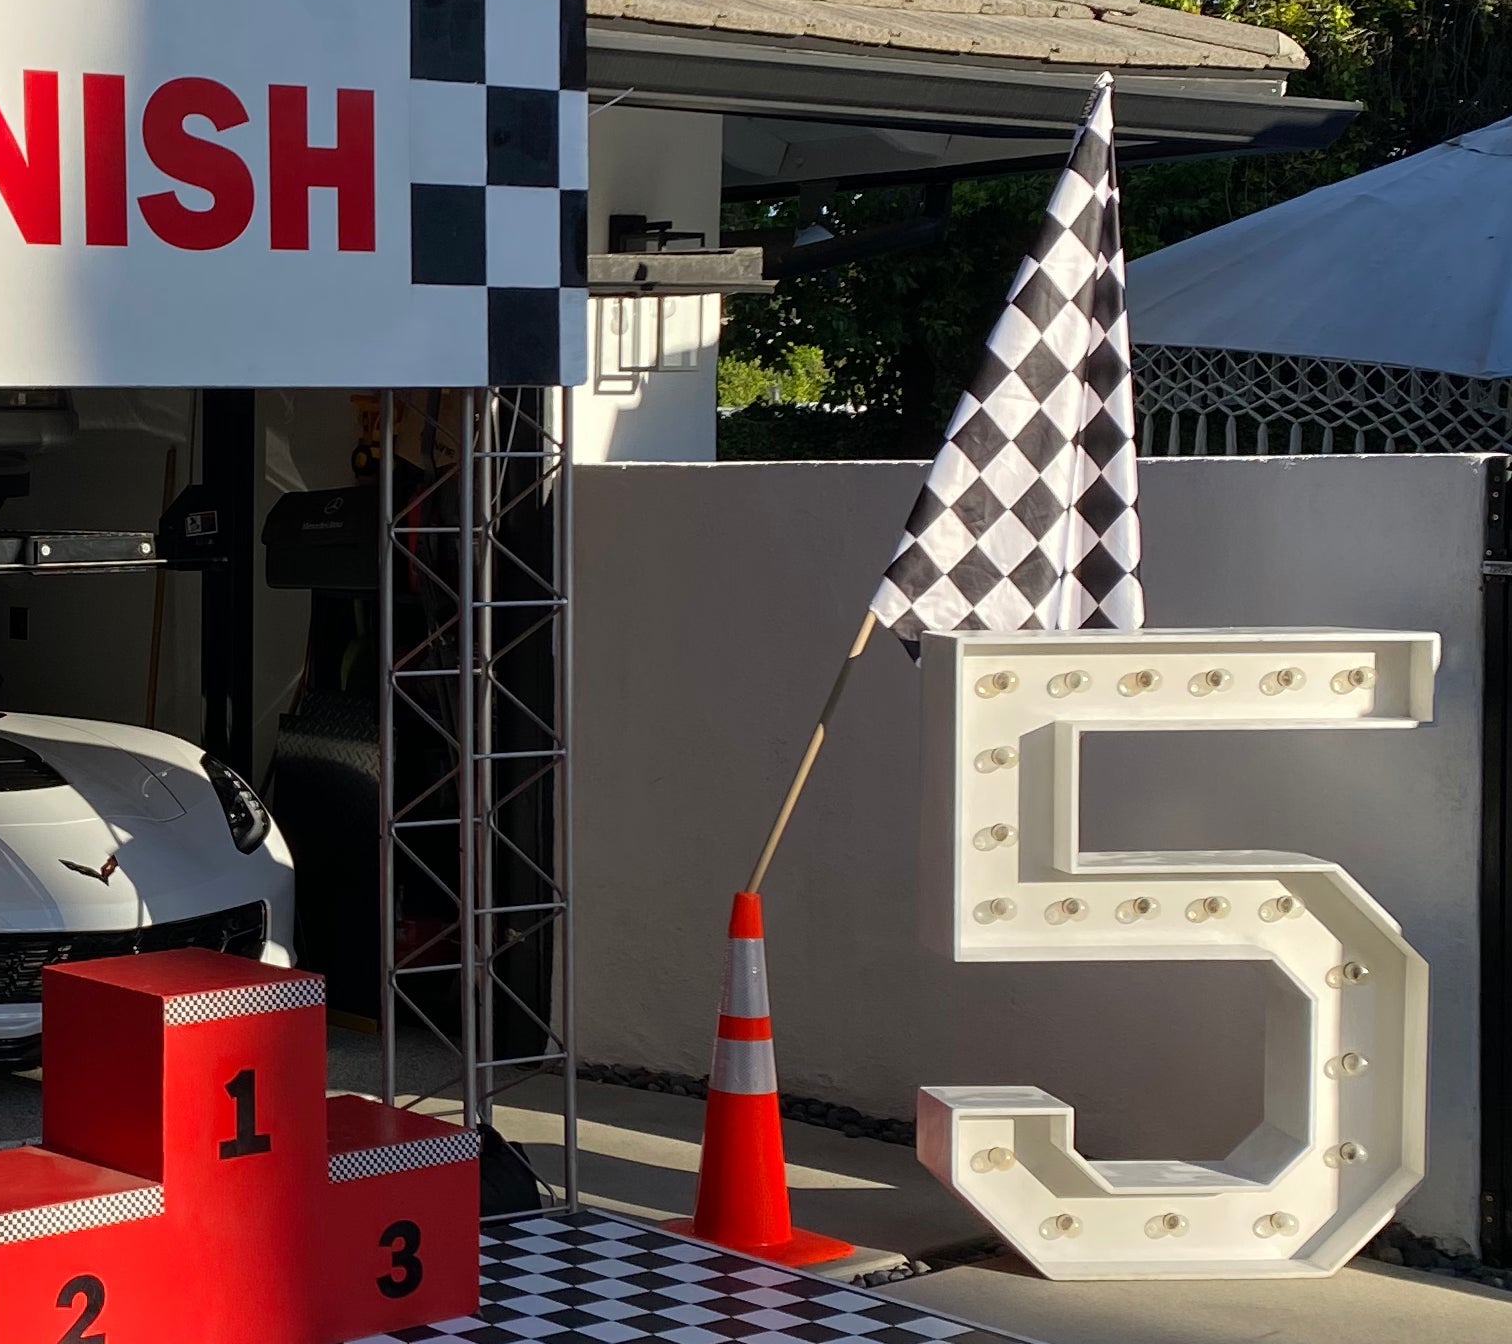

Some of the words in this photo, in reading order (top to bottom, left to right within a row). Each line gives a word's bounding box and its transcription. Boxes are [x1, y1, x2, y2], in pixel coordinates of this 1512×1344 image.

[917, 627, 1441, 1281] 5
[219, 1069, 271, 1159] 1
[376, 1219, 424, 1299] 3
